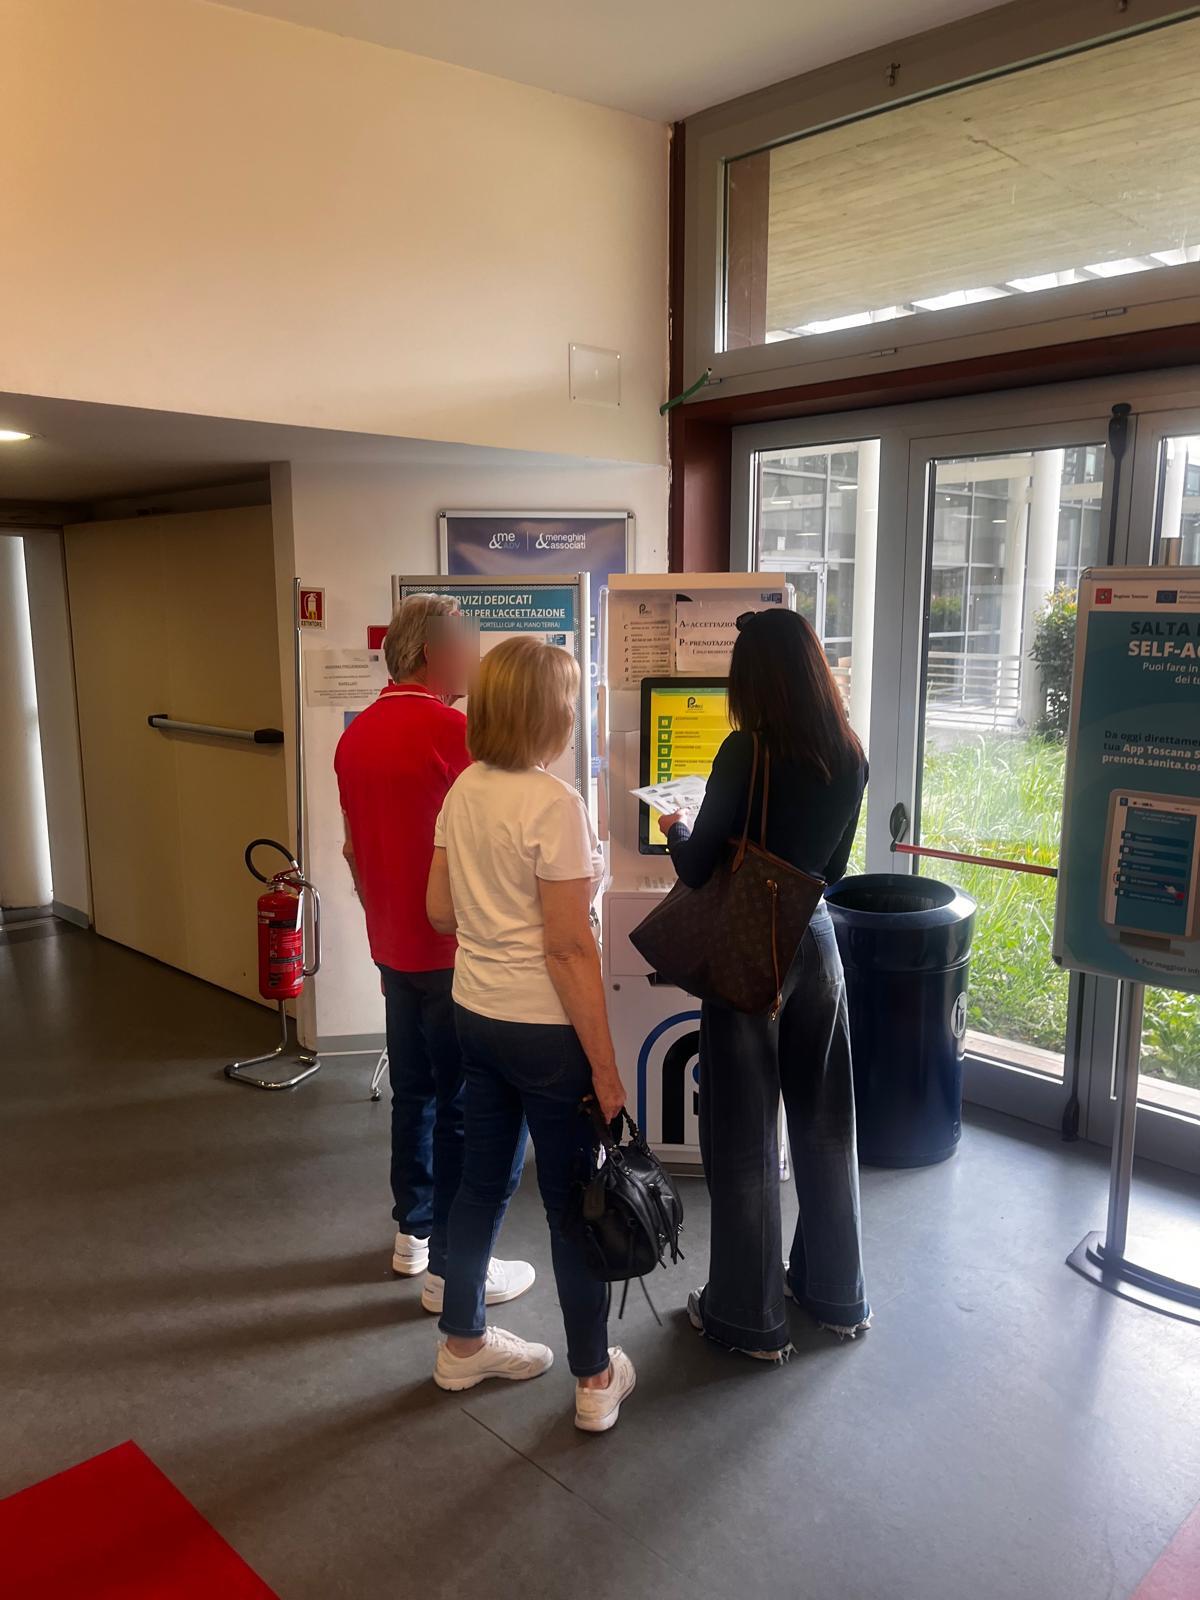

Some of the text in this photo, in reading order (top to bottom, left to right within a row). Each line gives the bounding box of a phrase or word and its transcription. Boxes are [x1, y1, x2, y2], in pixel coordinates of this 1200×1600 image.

[497, 532, 515, 542] me
[546, 532, 586, 544] meneghini
[550, 541, 586, 549] associati
[455, 594, 532, 605] RVIZI DEDICATI
[474, 608, 491, 617] PER
[492, 608, 566, 618] L'ACCETTAZIONE
[1129, 620, 1191, 637] SALTA
[1142, 661, 1164, 671] Puoi
[1166, 662, 1187, 672] fare
[1104, 730, 1118, 740] Da
[1120, 732, 1142, 744] oggi
[1103, 742, 1121, 751] tua
[1122, 743, 1144, 755] App
[1146, 745, 1192, 759] Toscana
[1101, 754, 1200, 772] prenota.sanita.tos
